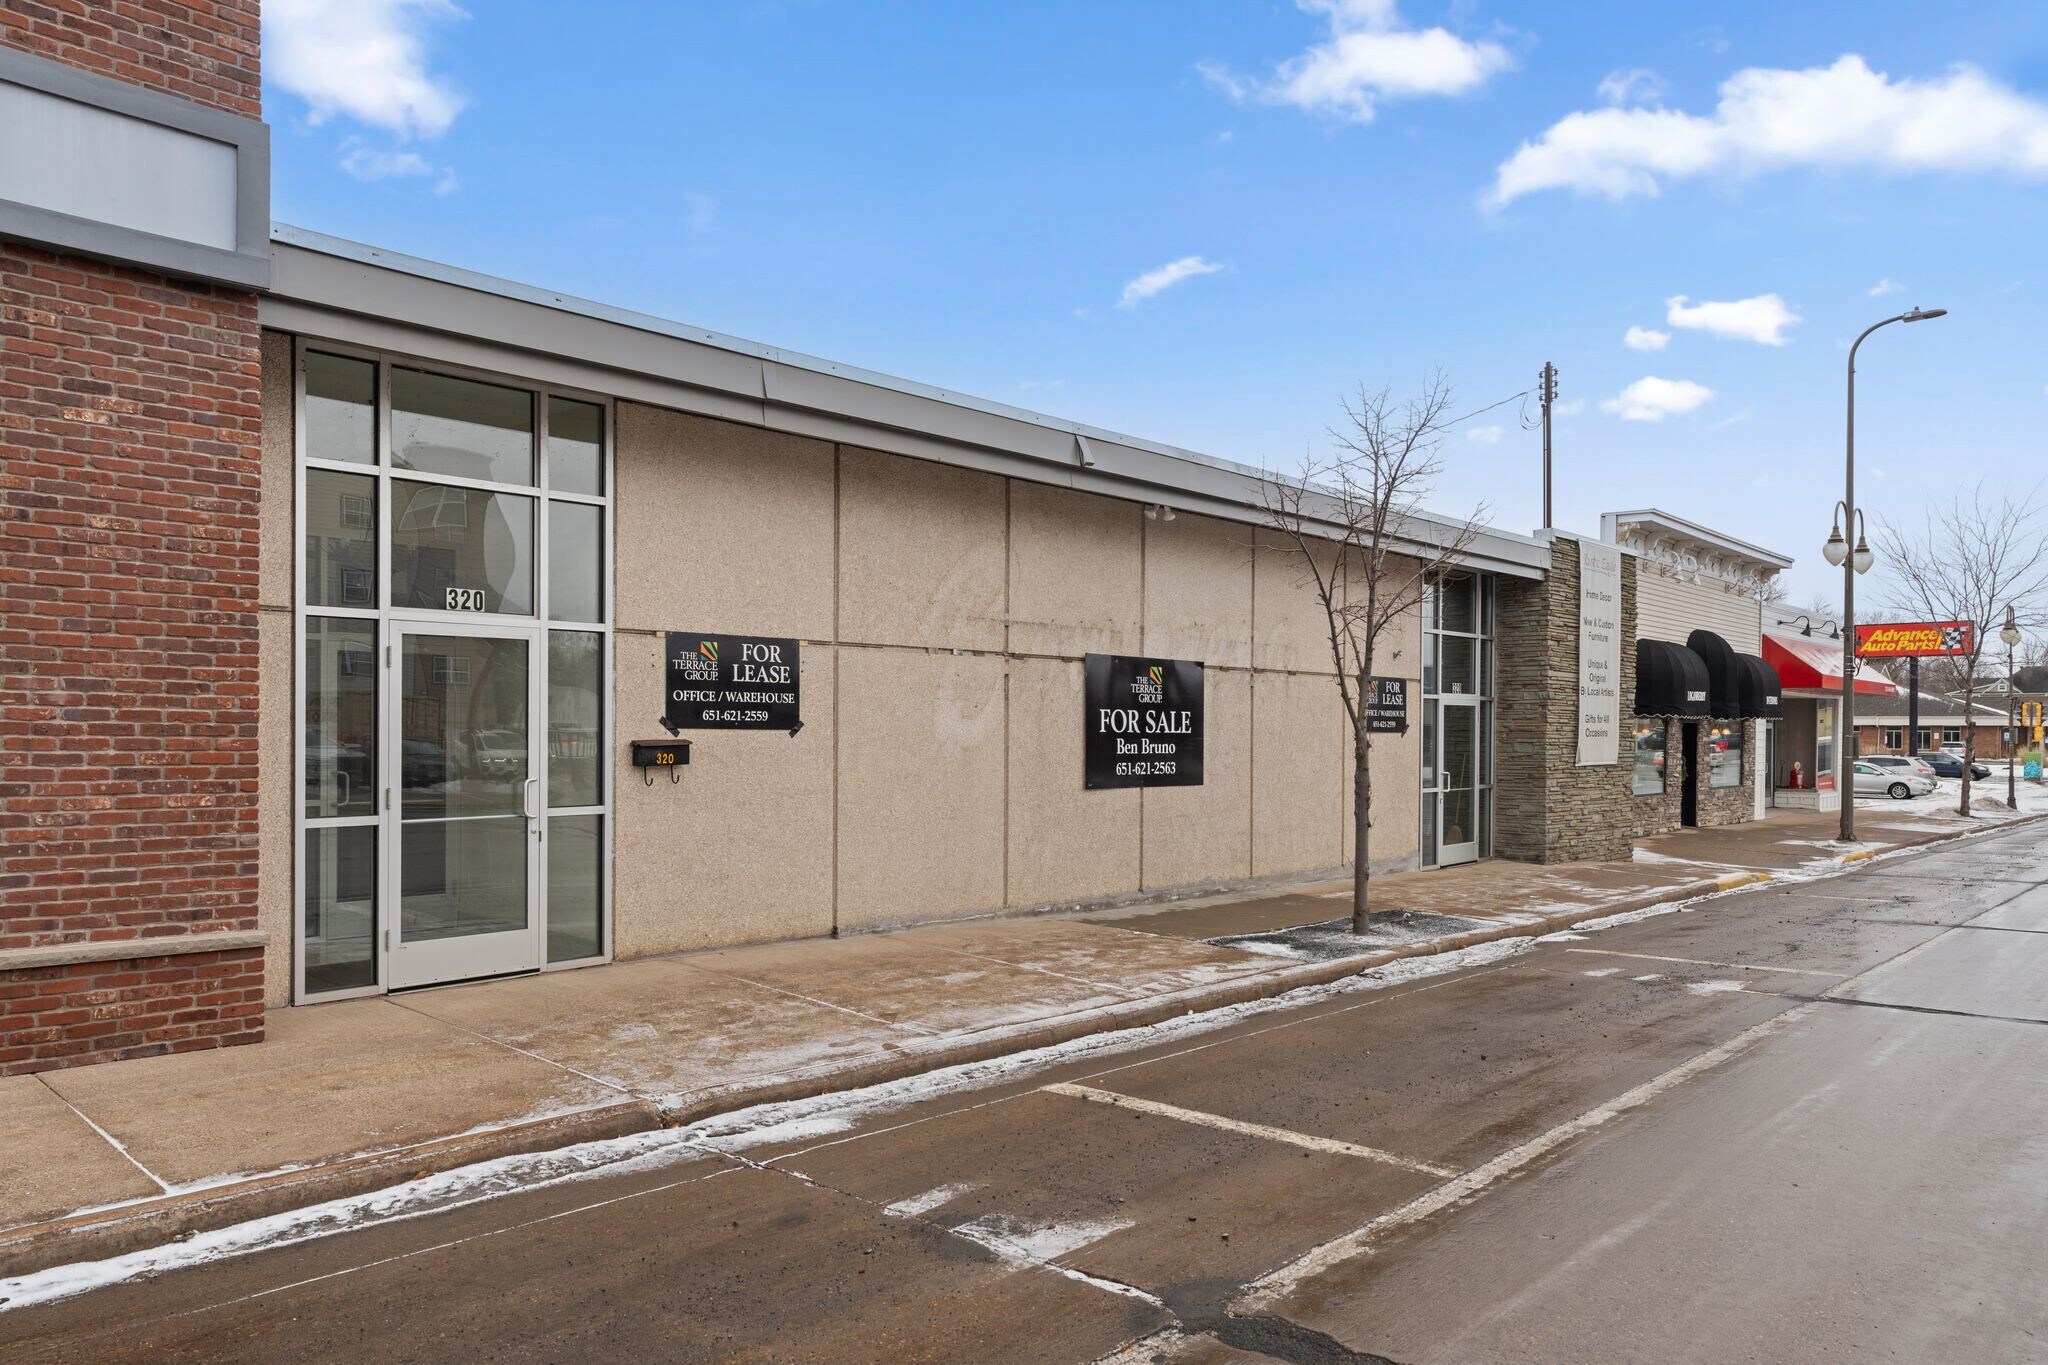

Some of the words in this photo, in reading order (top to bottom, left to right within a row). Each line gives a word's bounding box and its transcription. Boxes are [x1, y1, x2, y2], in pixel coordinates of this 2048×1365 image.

[448, 589, 483, 611] 320
[1868, 629, 1939, 642] Advance
[1860, 641, 1896, 652] Auto
[1896, 640, 1935, 651] Parts
[680, 651, 698, 660] THE
[741, 643, 782, 663] FOR
[673, 660, 718, 671] TERRACE
[732, 664, 791, 684] LEASE
[1136, 676, 1148, 685] THE
[1131, 684, 1162, 694] TERRACE
[1386, 681, 1400, 693] FOR
[673, 690, 716, 702] OFFICE
[725, 691, 795, 704] WAREHOUSE
[1382, 694, 1404, 706] LEASE
[702, 710, 769, 722] 651-621-2559
[1100, 708, 1141, 733] FOR
[1145, 710, 1192, 734] SALE
[1116, 738, 1138, 755] Ben
[1141, 738, 1176, 755] Bruno
[656, 753, 674, 764] 320
[1116, 762, 1176, 775] 651-621-2563
